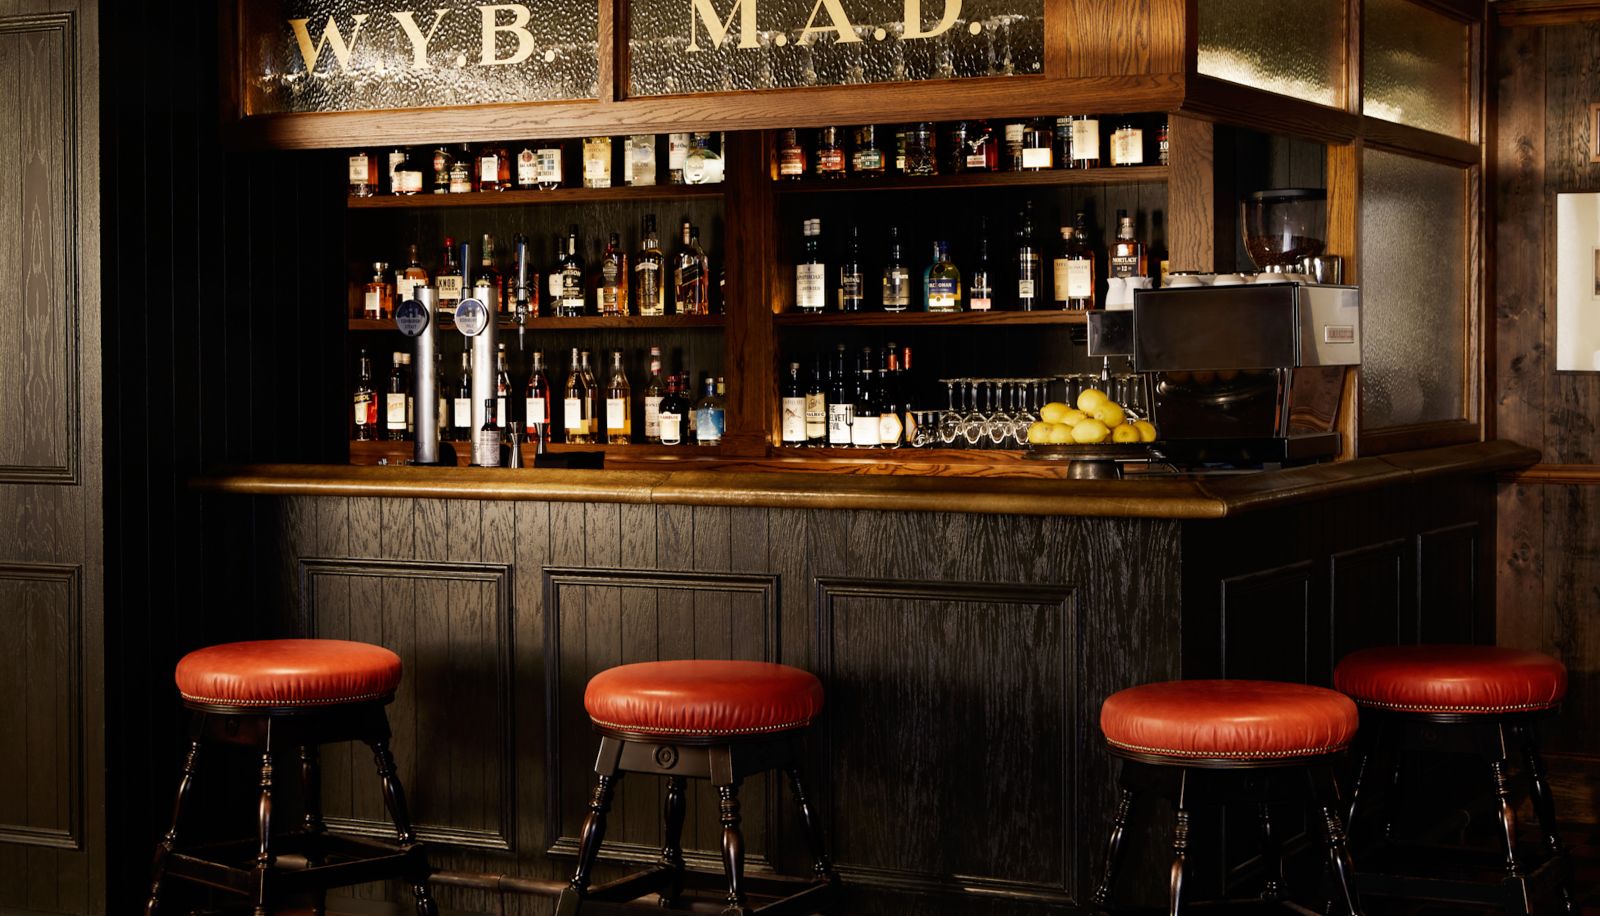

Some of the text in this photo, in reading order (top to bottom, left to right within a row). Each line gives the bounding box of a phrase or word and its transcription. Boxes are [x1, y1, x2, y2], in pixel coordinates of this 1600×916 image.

[288, 4, 555, 74] W.Y.B.
[685, 0, 982, 51] M.A.D.
[439, 279, 456, 287] KNOB
[830, 414, 845, 422] ELVET
